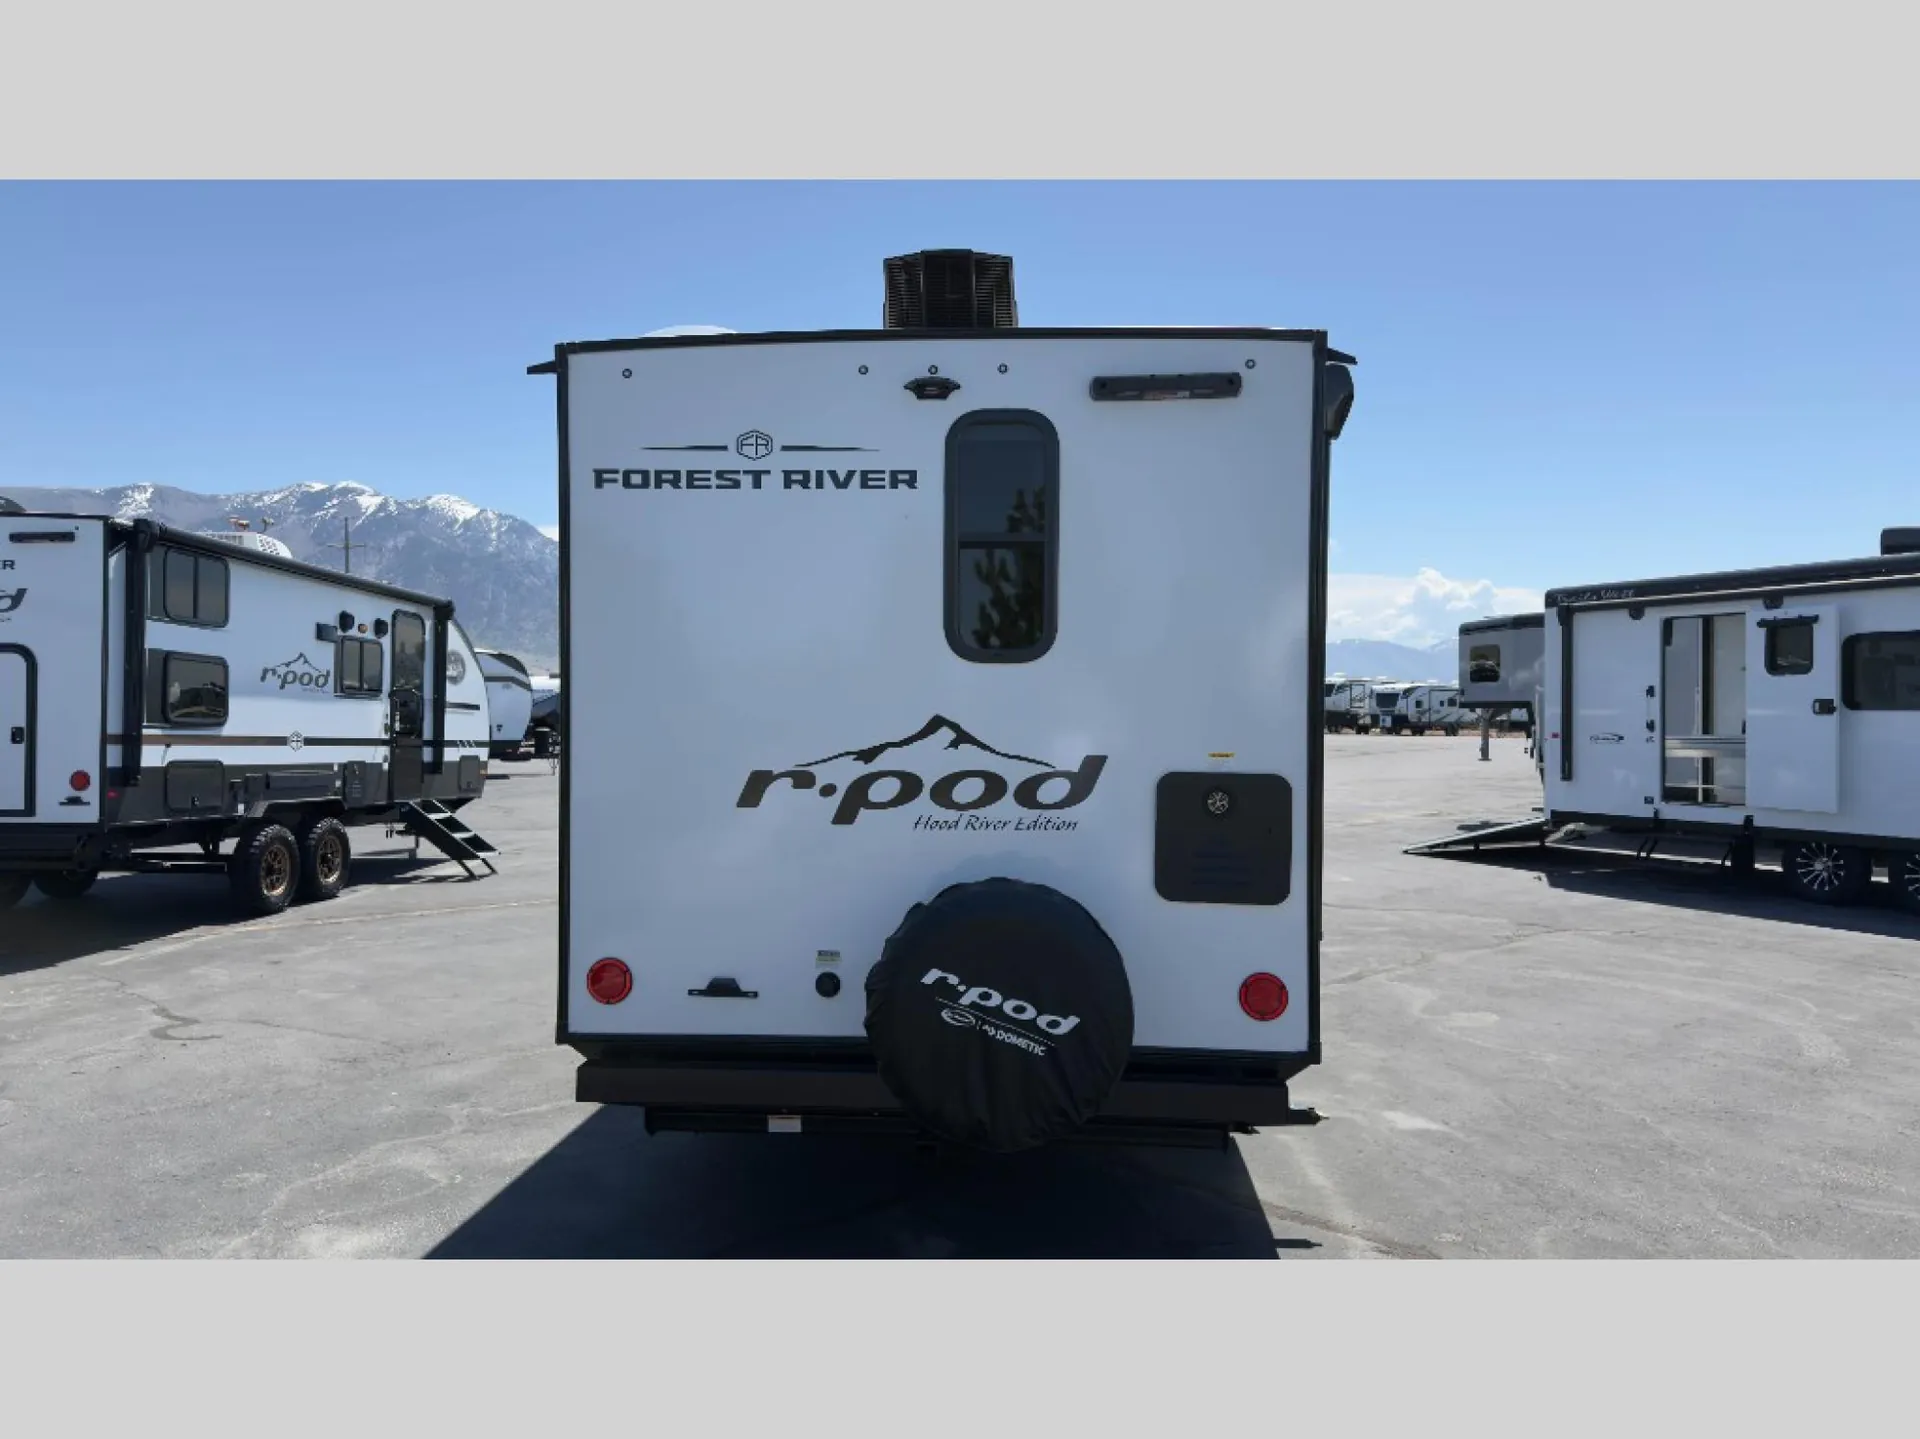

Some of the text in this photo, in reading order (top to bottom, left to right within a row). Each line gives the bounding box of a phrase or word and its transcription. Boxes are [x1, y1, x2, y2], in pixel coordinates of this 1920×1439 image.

[593, 468, 918, 490] FOREST RIVER
[913, 812, 1079, 831] Hood River Edition
[995, 1029, 1048, 1057] DOMETIC
